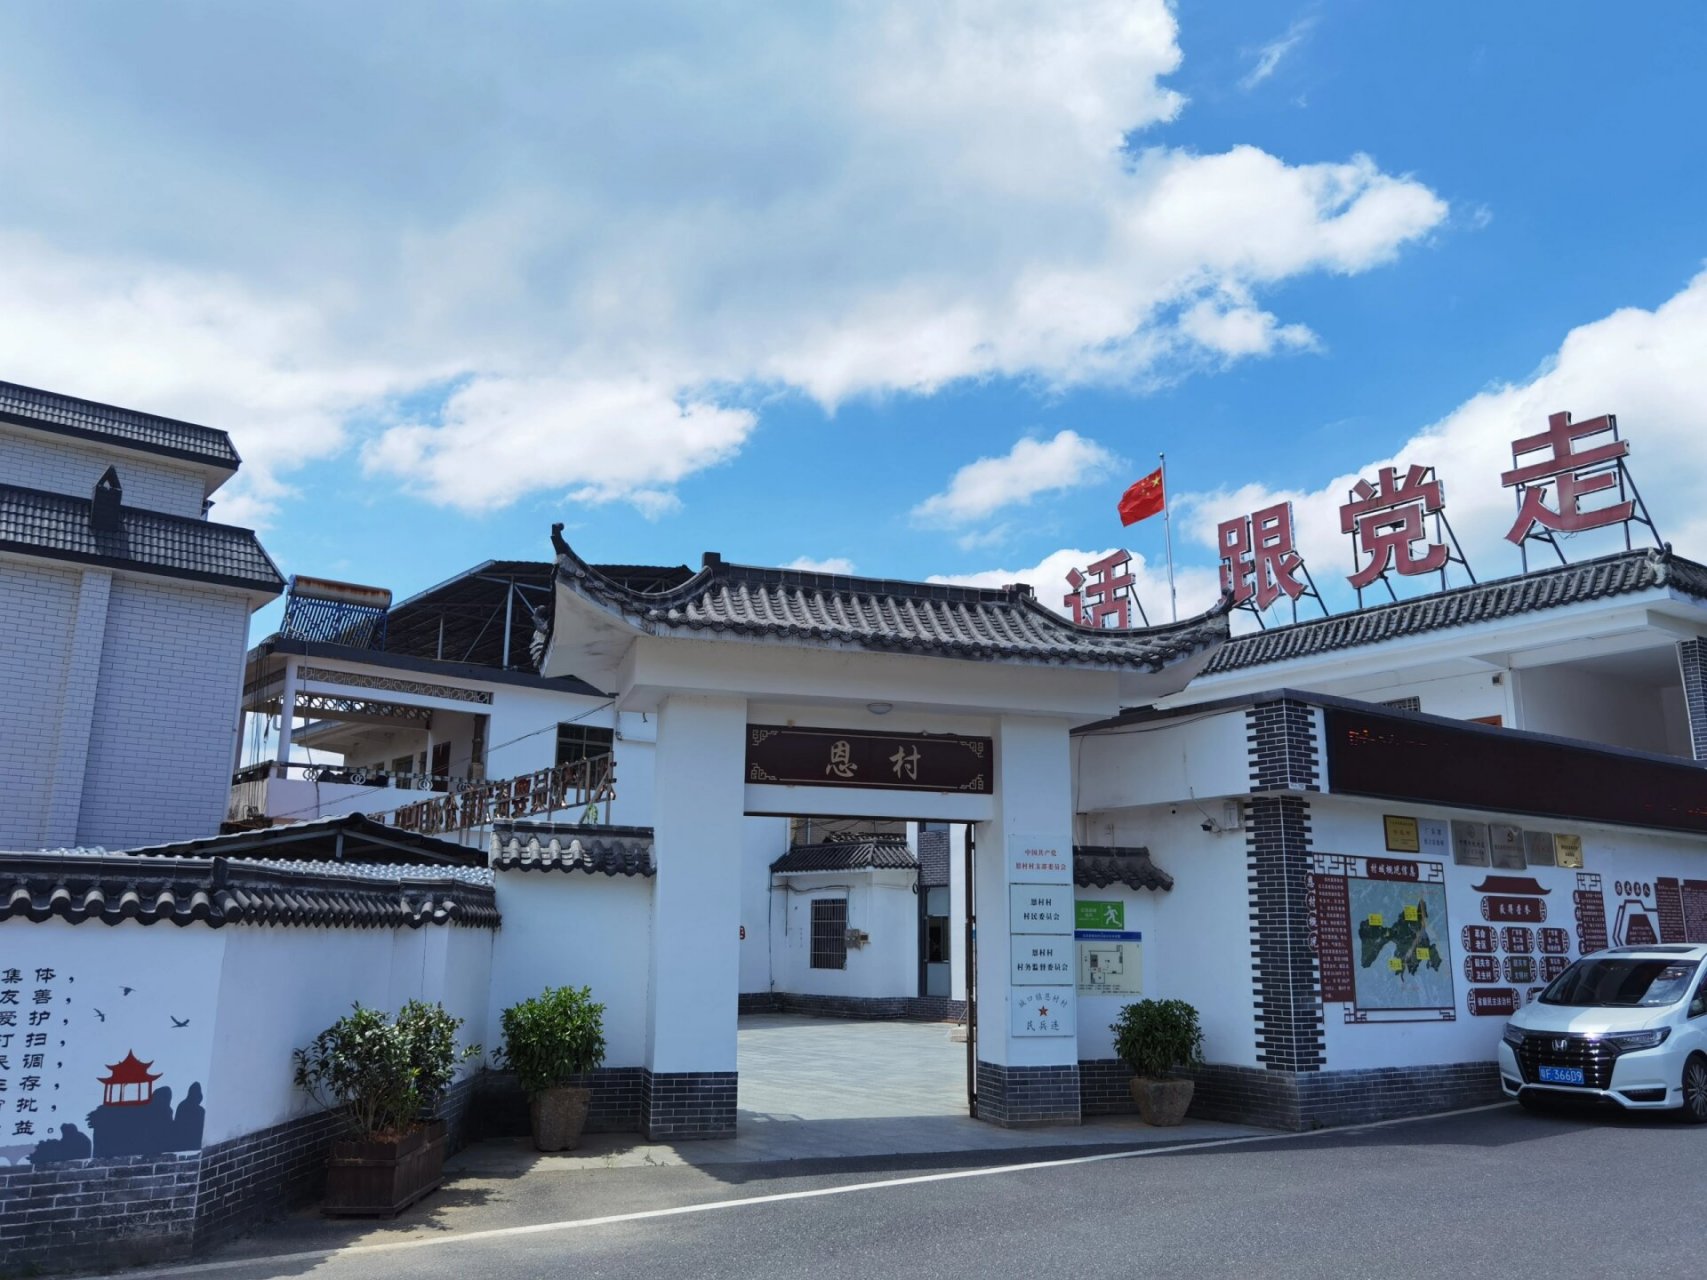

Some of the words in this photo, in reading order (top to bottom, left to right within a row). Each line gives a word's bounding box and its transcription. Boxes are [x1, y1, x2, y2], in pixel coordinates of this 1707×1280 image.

[825, 740, 921, 781] 恩村
[1025, 848, 1057, 857] 中国共产党
[1030, 898, 1052, 907] 恩村村
[1023, 913, 1060, 921] 村民委员会
[1032, 948, 1053, 957] 恩村村
[1017, 963, 1068, 971] 村务监督委员会
[1, 967, 75, 984] 集体，
[0, 989, 72, 1005] 友善，
[0, 1010, 69, 1027] 爱护，
[1026, 1020, 1060, 1031] 民兵连
[0, 1097, 57, 1114] 批，
